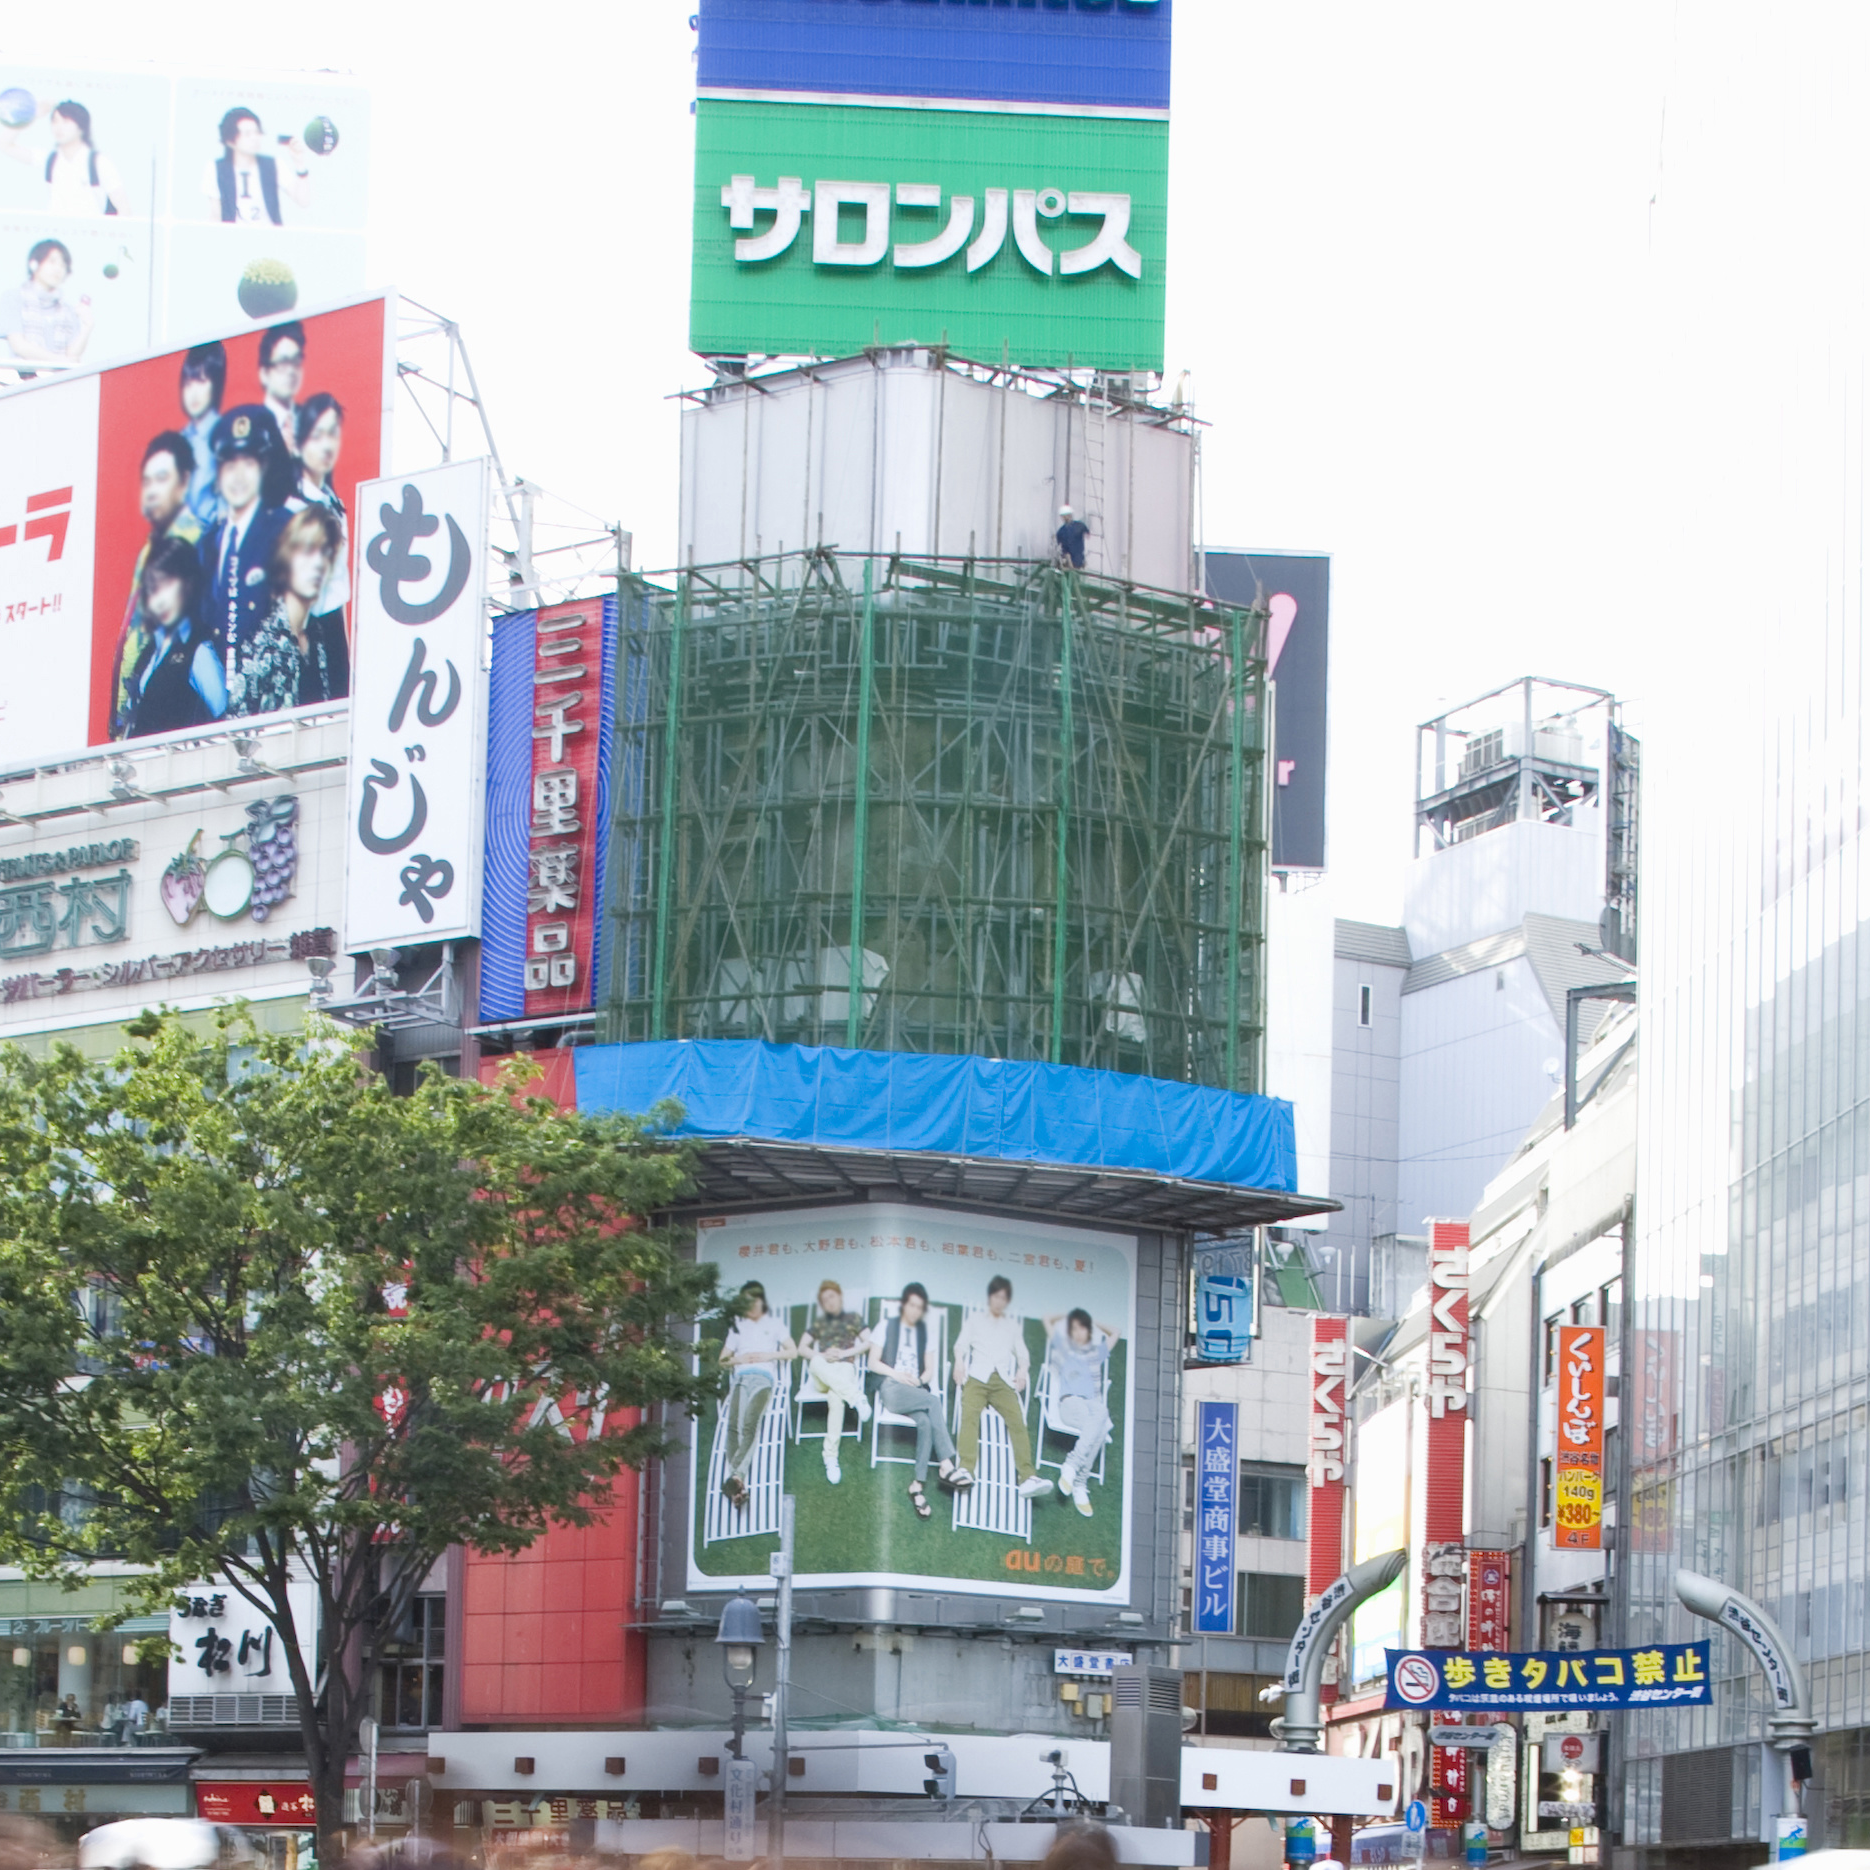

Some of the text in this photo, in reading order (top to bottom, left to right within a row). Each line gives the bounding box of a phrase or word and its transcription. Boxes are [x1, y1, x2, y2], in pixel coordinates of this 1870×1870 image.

[721, 174, 1142, 280] サロンパス
[358, 484, 471, 924] もんじゃ
[524, 613, 588, 991] 三千里薬品
[1428, 1245, 1470, 1419] さくらや
[1311, 1337, 1346, 1489] さくらや
[1201, 1416, 1231, 1618] 大盛堂商事ビル
[1563, 1485, 1595, 1501] 140g
[1566, 1531, 1590, 1545] 4F
[195, 1625, 273, 1678] 松川
[1443, 1648, 1706, 1690] 歩きタバコ禁止
